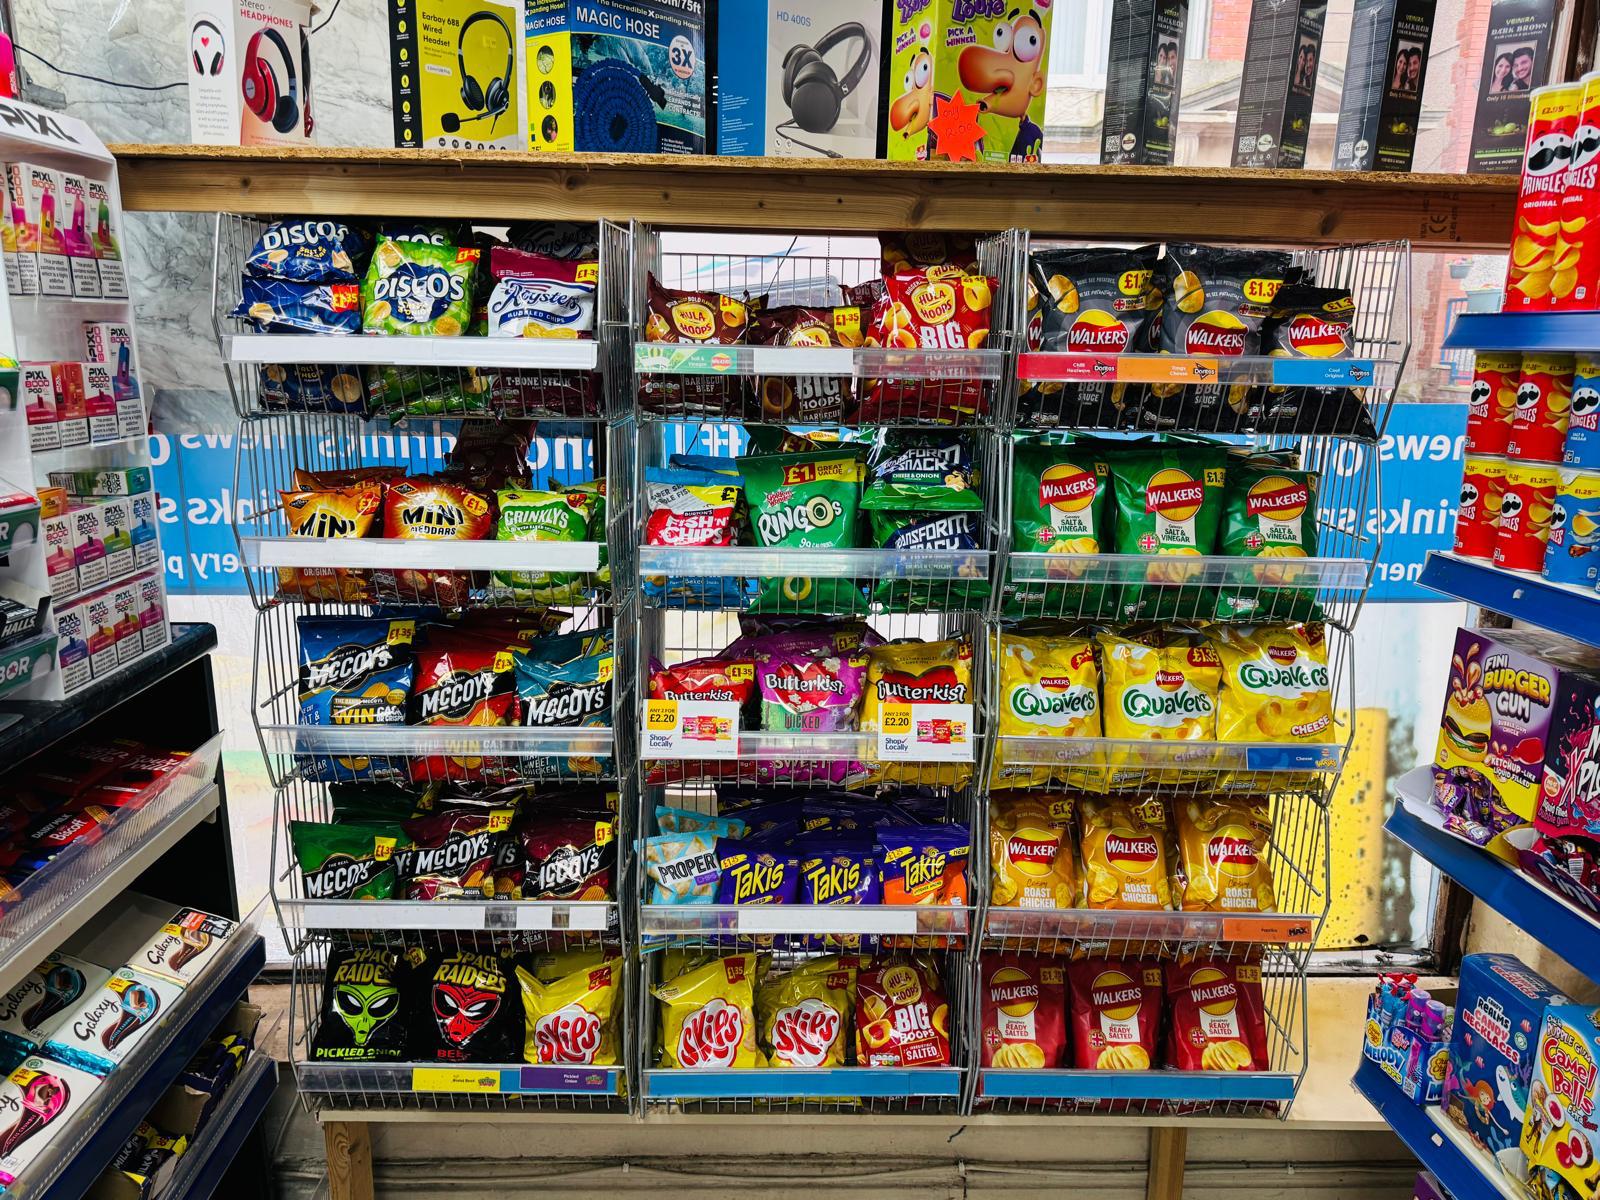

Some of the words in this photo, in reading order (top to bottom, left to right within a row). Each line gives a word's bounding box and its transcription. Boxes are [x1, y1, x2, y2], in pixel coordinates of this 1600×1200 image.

[611, 2, 647, 16] Incredible
[240, 9, 293, 29] HEADPHONES
[447, 18, 460, 27] 688
[546, 16, 566, 26] HOSE
[576, 6, 622, 30] MAGIC
[625, 17, 660, 39] HOSE
[776, 11, 788, 22] HD
[791, 14, 811, 27] 400S
[423, 24, 443, 35] Wired
[947, 28, 964, 37] PICK
[1516, 22, 1548, 32] BROWN
[423, 35, 450, 47] Headset
[896, 33, 908, 45] PICK
[946, 35, 976, 46] WINNER!
[671, 47, 693, 69] 3X
[32, 170, 53, 183] PIXL
[65, 177, 83, 189] PIXL
[89, 183, 106, 194] PIXL
[1521, 171, 1567, 198] PRINGLES
[1523, 199, 1557, 208] ORIGINAL
[263, 221, 350, 250] DISCOS
[374, 273, 464, 301] DISCOS
[919, 290, 947, 304] HULA
[680, 312, 706, 322] HULA
[920, 301, 953, 319] HOOPS
[546, 313, 565, 323] CHIPS
[835, 313, 859, 326] £1.35
[110, 328, 128, 337] PIXL
[680, 323, 712, 334] HOOPS
[920, 323, 965, 349] BIG
[1070, 328, 1127, 345] WALKERS
[1188, 329, 1244, 347] WALKERS
[25, 371, 47, 380] PIXL
[89, 368, 108, 376] PIXL
[817, 464, 843, 472] GREAT
[818, 469, 843, 477] VALUE
[1042, 477, 1095, 499] WALKERS
[1148, 488, 1202, 506] WALKERS
[1249, 491, 1307, 509] WALKERS
[105, 505, 123, 515] PIXL
[78, 512, 96, 523] PIXL
[504, 508, 569, 528] CRINKLYS
[666, 516, 712, 528] FISH
[47, 522, 66, 532] PIXL
[1165, 528, 1180, 536] SALT
[663, 528, 724, 544] CHIPS
[1162, 534, 1190, 543] VINEGAR
[1266, 533, 1297, 541] VINEGAR
[115, 590, 132, 602] PIXL
[89, 601, 107, 613] PIXL
[59, 613, 79, 624] PIXL
[2, 616, 36, 638] HALLS
[1192, 649, 1220, 663] £1.35
[1269, 648, 1297, 657] WALKERS
[1485, 654, 1509, 671] FINI
[732, 667, 753, 677] £1.35
[1156, 673, 1184, 682] WALKERS
[1240, 664, 1328, 689] Quavers
[765, 674, 845, 695] Butterkist
[877, 680, 966, 701] Butterkist
[1483, 670, 1550, 706] BURGER
[664, 689, 734, 701] Butterkist
[1012, 687, 1096, 717] Quavers
[1123, 688, 1212, 718] Quavers
[1497, 693, 1530, 720] GUM
[650, 713, 675, 723] £2.20
[785, 714, 820, 729] WICKED
[885, 718, 909, 727] £2.20
[1291, 715, 1330, 736] CHEESE
[1498, 720, 1514, 730] BUBBLE
[1515, 725, 1527, 734] GUM
[649, 734, 667, 743] Shop
[649, 740, 673, 748] Locally
[885, 743, 909, 751] Locally
[1493, 766, 1511, 779] LIQUID
[1511, 774, 1531, 788] FILLED
[1134, 806, 1163, 820] £1.35
[490, 816, 511, 828] £1.35
[49, 819, 88, 840] Biscoff
[1107, 840, 1157, 854] WALKERS
[658, 853, 717, 884] PROPER
[901, 855, 946, 892] Takis
[731, 864, 785, 905] Takis
[808, 864, 860, 905] Takis
[1125, 884, 1151, 893] ROAST
[1024, 888, 1050, 898] ROAST
[1122, 893, 1158, 903] CHICKEN
[1225, 888, 1252, 898] ROAST
[1019, 898, 1056, 908] CHICKEN
[1221, 897, 1257, 908] CHICKEN
[1289, 928, 1308, 937] MAX
[146, 933, 181, 965] Galaxy
[442, 951, 498, 972] SPACE
[433, 964, 507, 993] RAIDERS
[889, 974, 912, 988] HULA
[991, 984, 1038, 1002] WALKERS
[1093, 988, 1142, 1006] WALKERS
[1191, 983, 1237, 1002] WALKERS
[74, 996, 120, 1040] Galaxy
[895, 1003, 930, 1032] BIG
[1474, 1009, 1509, 1042] CANDY
[1463, 1011, 1519, 1062] NECKLACES
[1547, 1023, 1574, 1046] BUBBLE
[1574, 1042, 1592, 1063] GUM
[316, 1048, 365, 1058] PICKLED
[906, 1048, 938, 1061] SALTED
[1545, 1038, 1598, 1091] Camel
[1552, 1066, 1595, 1116] Balls
